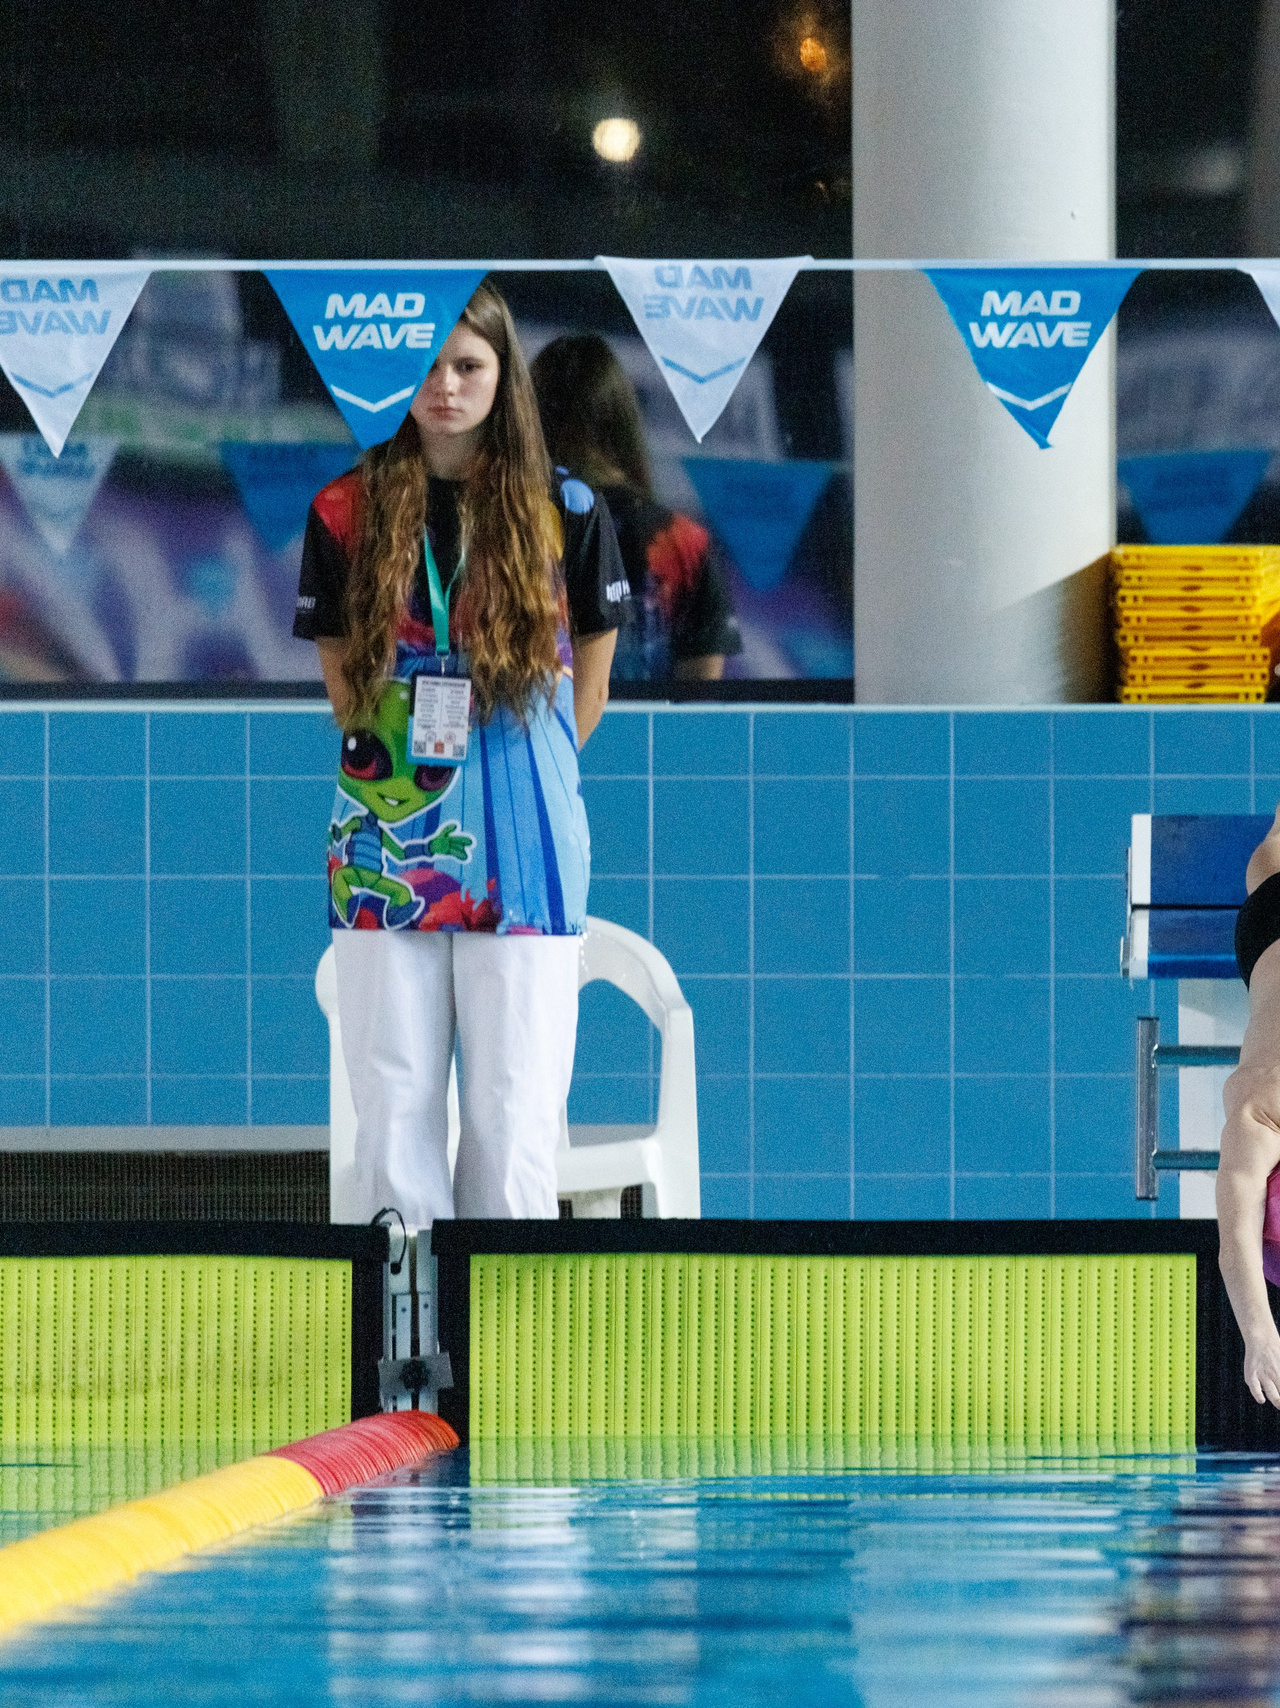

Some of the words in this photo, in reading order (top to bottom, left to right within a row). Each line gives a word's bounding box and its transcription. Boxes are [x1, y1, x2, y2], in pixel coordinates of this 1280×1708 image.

[325, 293, 426, 318] MAD
[981, 290, 1081, 316] MAD
[313, 322, 435, 350] WAVE
[968, 321, 1092, 348] WAVE
